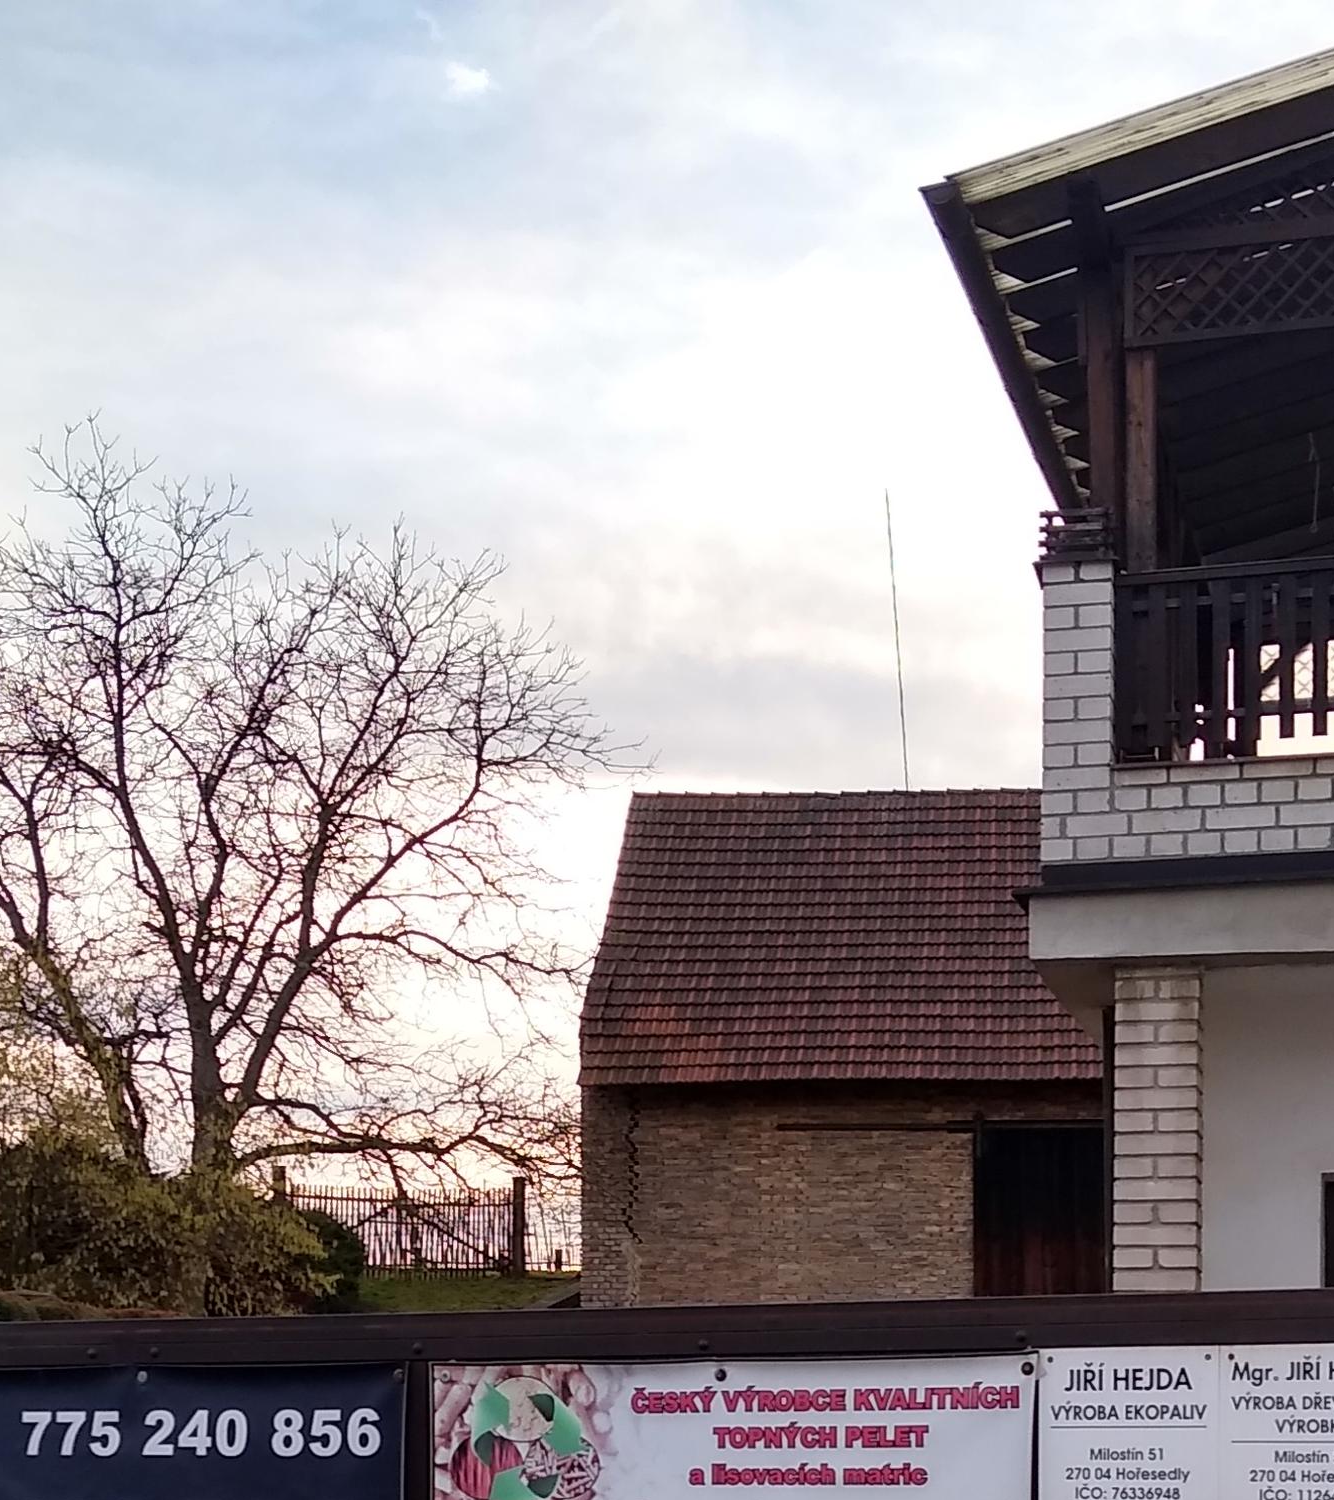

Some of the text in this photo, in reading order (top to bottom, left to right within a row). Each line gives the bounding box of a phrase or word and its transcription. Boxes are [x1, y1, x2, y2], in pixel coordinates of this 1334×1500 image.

[1064, 1362, 1193, 1392] JIŘÍ HEJDA
[1231, 1362, 1279, 1387] Mgr.
[1286, 1355, 1321, 1381] JIŘÍ
[631, 1382, 1020, 1413] ČESKÝ VÝROBCE KVALITNÍCH
[1231, 1392, 1297, 1410] VÝROBA
[1050, 1401, 1207, 1420] VÝROBA EKOPALIV
[21, 1408, 381, 1457] 775 240 856
[713, 1421, 929, 1448] TOPNÝCH PELET
[1089, 1448, 1165, 1461] Milostín 51
[1274, 1450, 1329, 1463] Milostín
[689, 1463, 928, 1485] a lisovacích matric
[1065, 1468, 1190, 1483] 270 04 Hořesedly
[1249, 1470, 1275, 1482] 270
[1279, 1470, 1296, 1482] 04
[1075, 1484, 1180, 1500] IČO: 76336948
